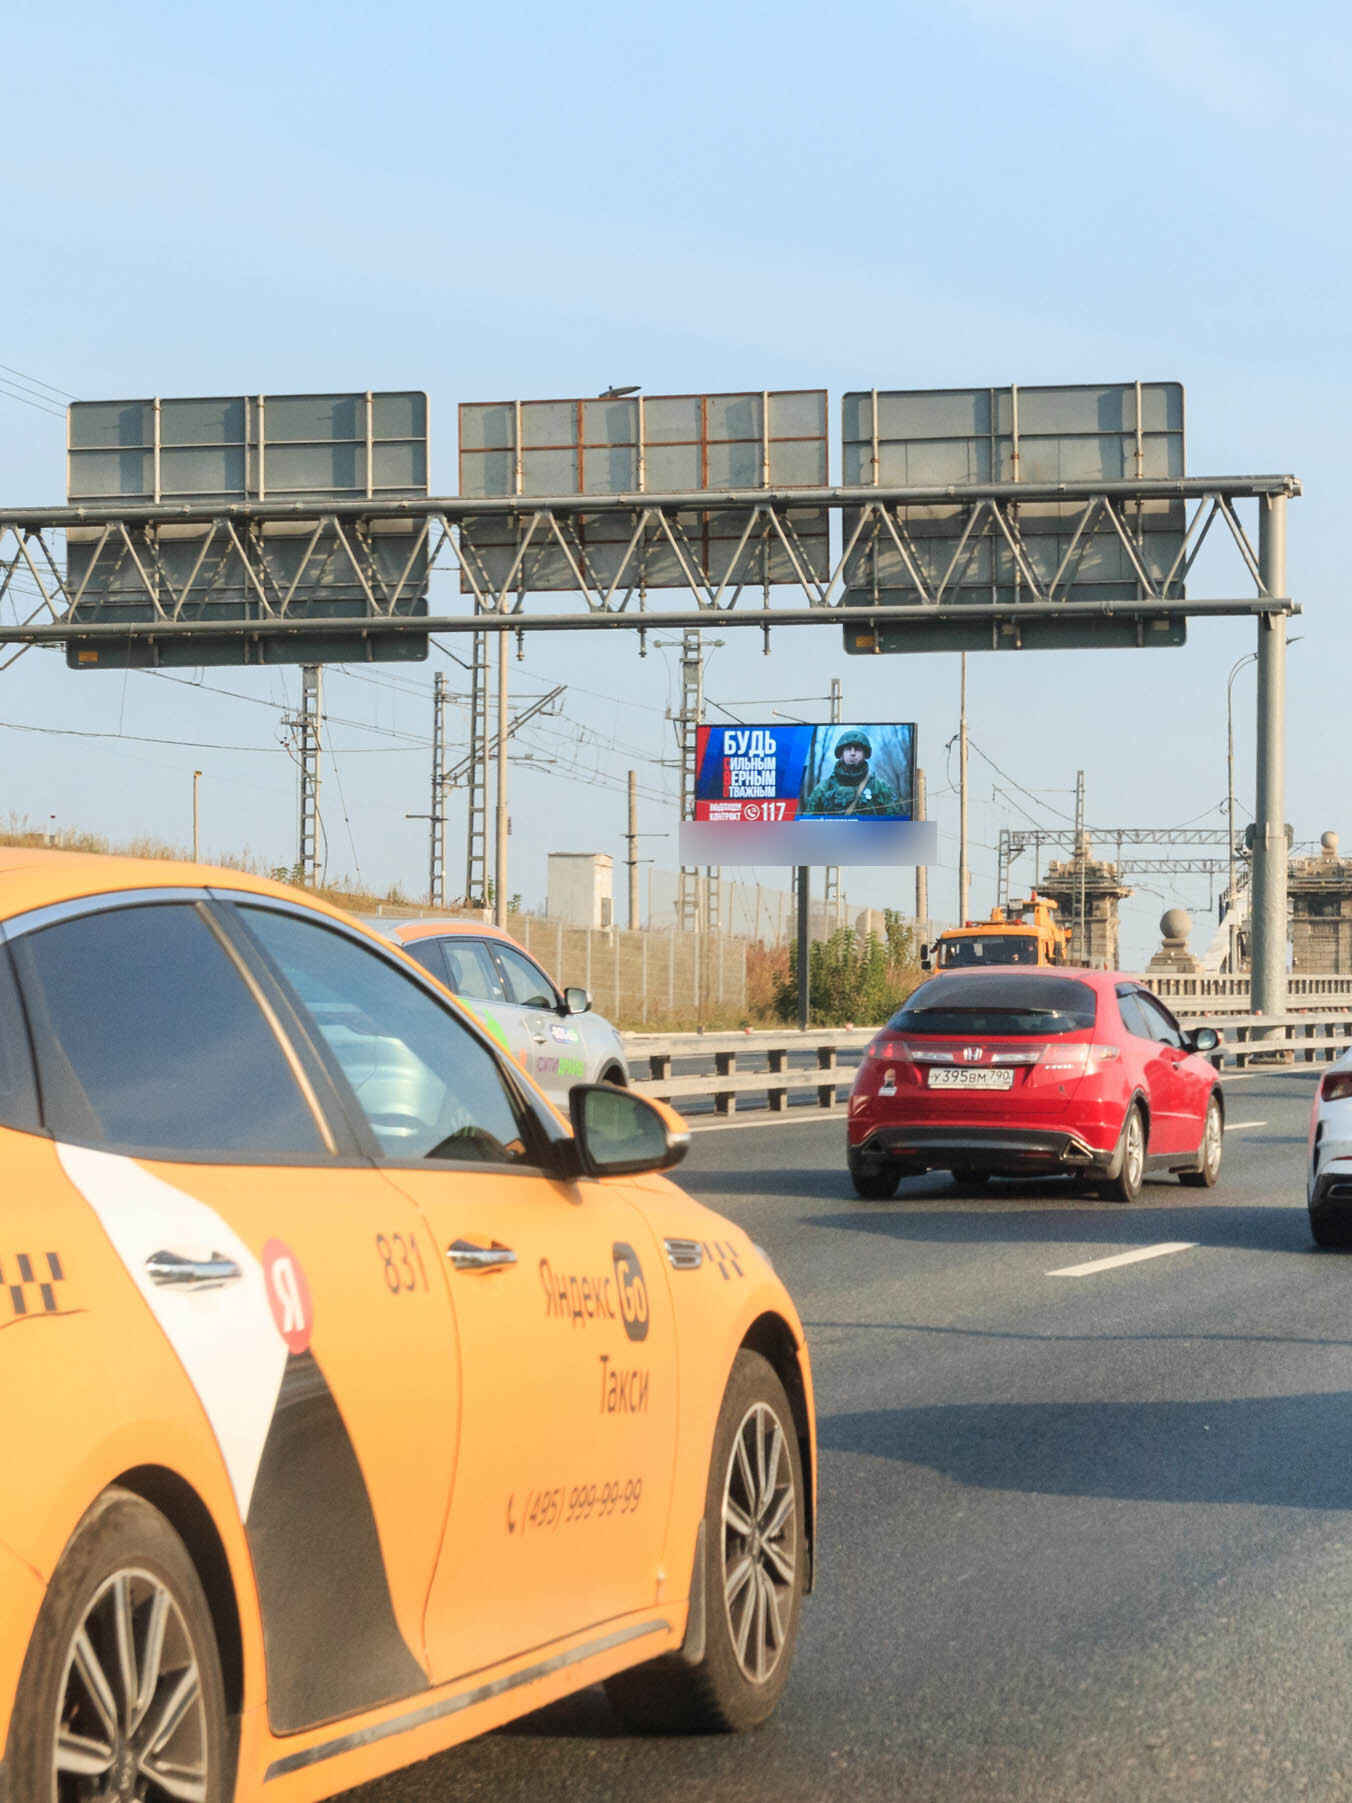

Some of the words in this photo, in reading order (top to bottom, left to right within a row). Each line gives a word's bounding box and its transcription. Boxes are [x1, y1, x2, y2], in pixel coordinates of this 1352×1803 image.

[723, 757, 776, 770] СИЛЬНЫМ
[724, 730, 776, 757] БУДЬ
[723, 770, 776, 786] ВЕРНЫМ
[723, 786, 776, 798] ОТВАЖНЫМ
[761, 802, 786, 821] 117
[376, 1232, 430, 1295] 831
[272, 1257, 305, 1333] Я
[539, 1258, 616, 1329] Яндекс
[616, 1259, 648, 1324] Go
[600, 1354, 649, 1414] Такси
[520, 1485, 566, 1536] (495)
[565, 1477, 643, 1523] 999-99-99
